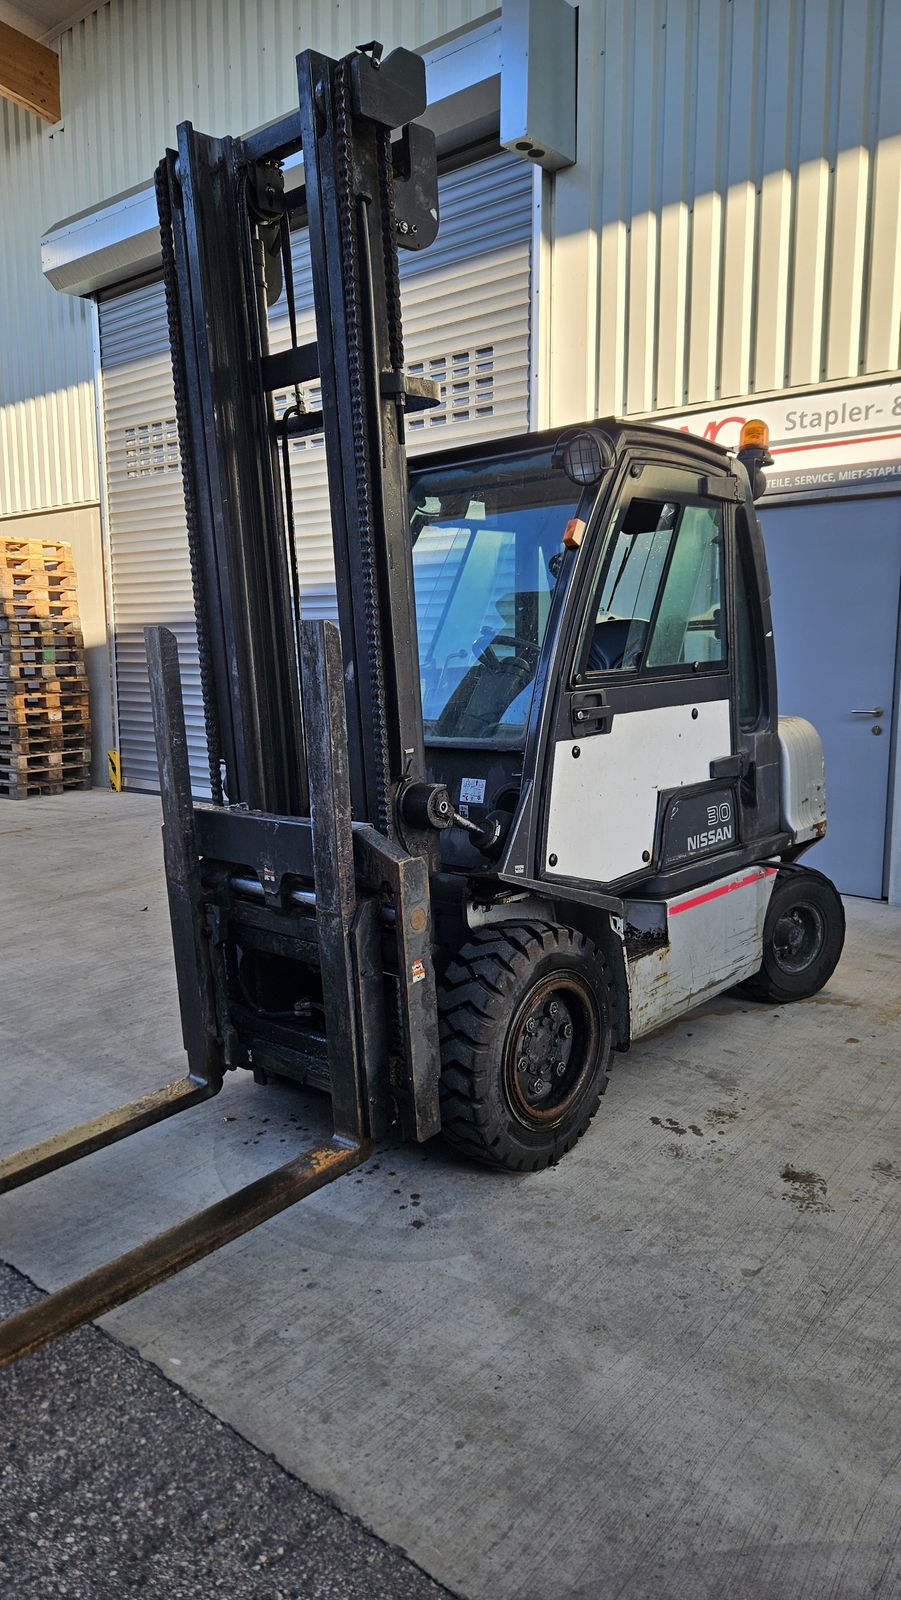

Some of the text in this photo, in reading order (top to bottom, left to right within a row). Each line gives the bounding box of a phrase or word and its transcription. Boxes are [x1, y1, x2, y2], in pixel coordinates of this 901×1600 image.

[785, 402, 884, 432] Stapler-
[794, 472, 836, 486] SERVICE,
[706, 802, 731, 826] 30
[687, 825, 732, 851] NISSAN
